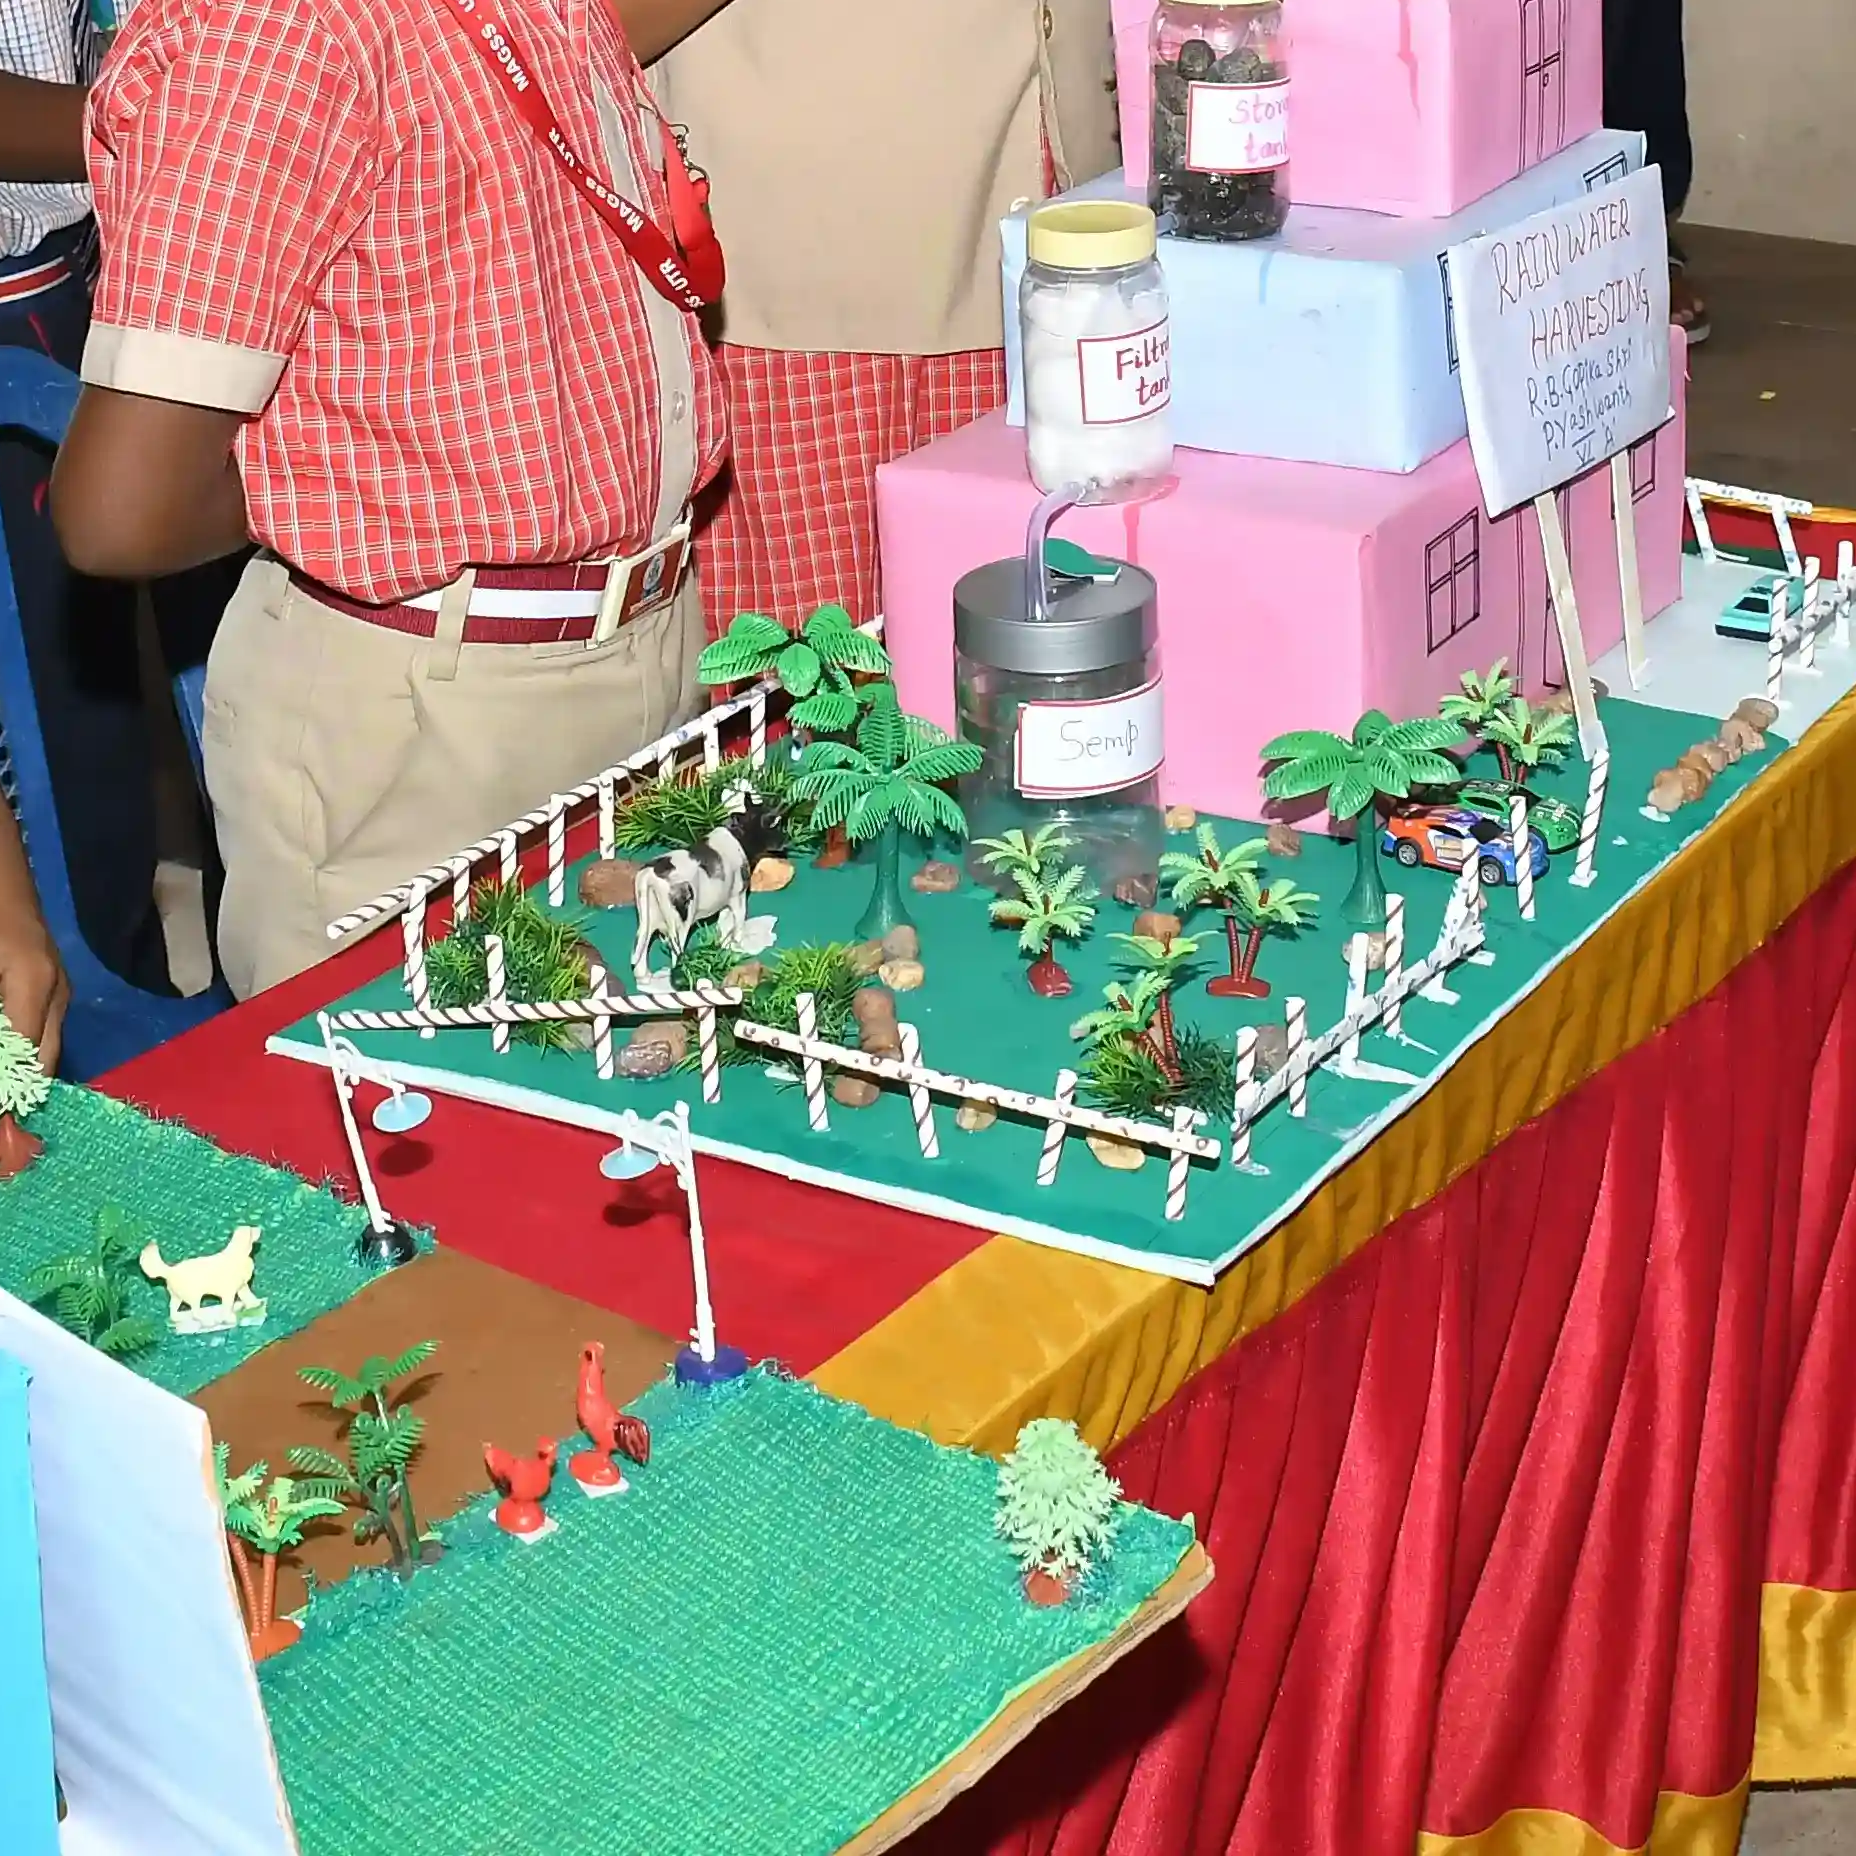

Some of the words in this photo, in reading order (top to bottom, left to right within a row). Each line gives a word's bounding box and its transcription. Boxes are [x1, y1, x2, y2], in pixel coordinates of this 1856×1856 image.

[481, 23, 529, 92] MAGSS
[548, 127, 575, 167] UTR
[659, 257, 688, 291] UTR
[1491, 224, 1560, 315] RAIN
[1566, 197, 1630, 264] WATER
[1530, 268, 1650, 370] HARVESTING
